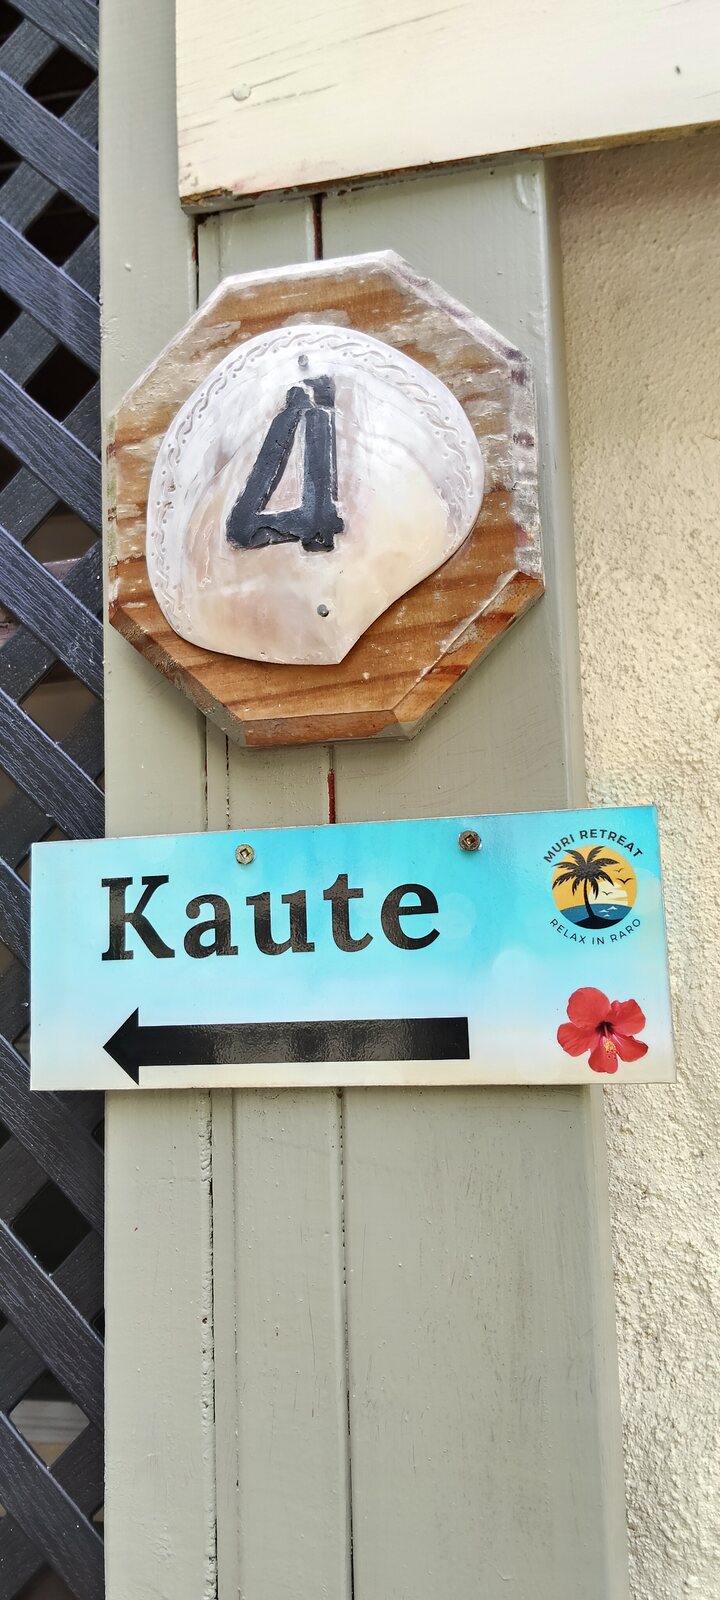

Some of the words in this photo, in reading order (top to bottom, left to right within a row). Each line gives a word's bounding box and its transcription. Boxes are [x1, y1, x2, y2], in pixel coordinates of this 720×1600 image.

[226, 375, 344, 552] 4
[543, 834, 575, 863] MURI
[579, 829, 643, 858] RETREAT
[101, 874, 440, 961] Kaute
[550, 918, 586, 944] RELAX
[592, 937, 605, 945] IN
[610, 918, 641, 943] RARO
